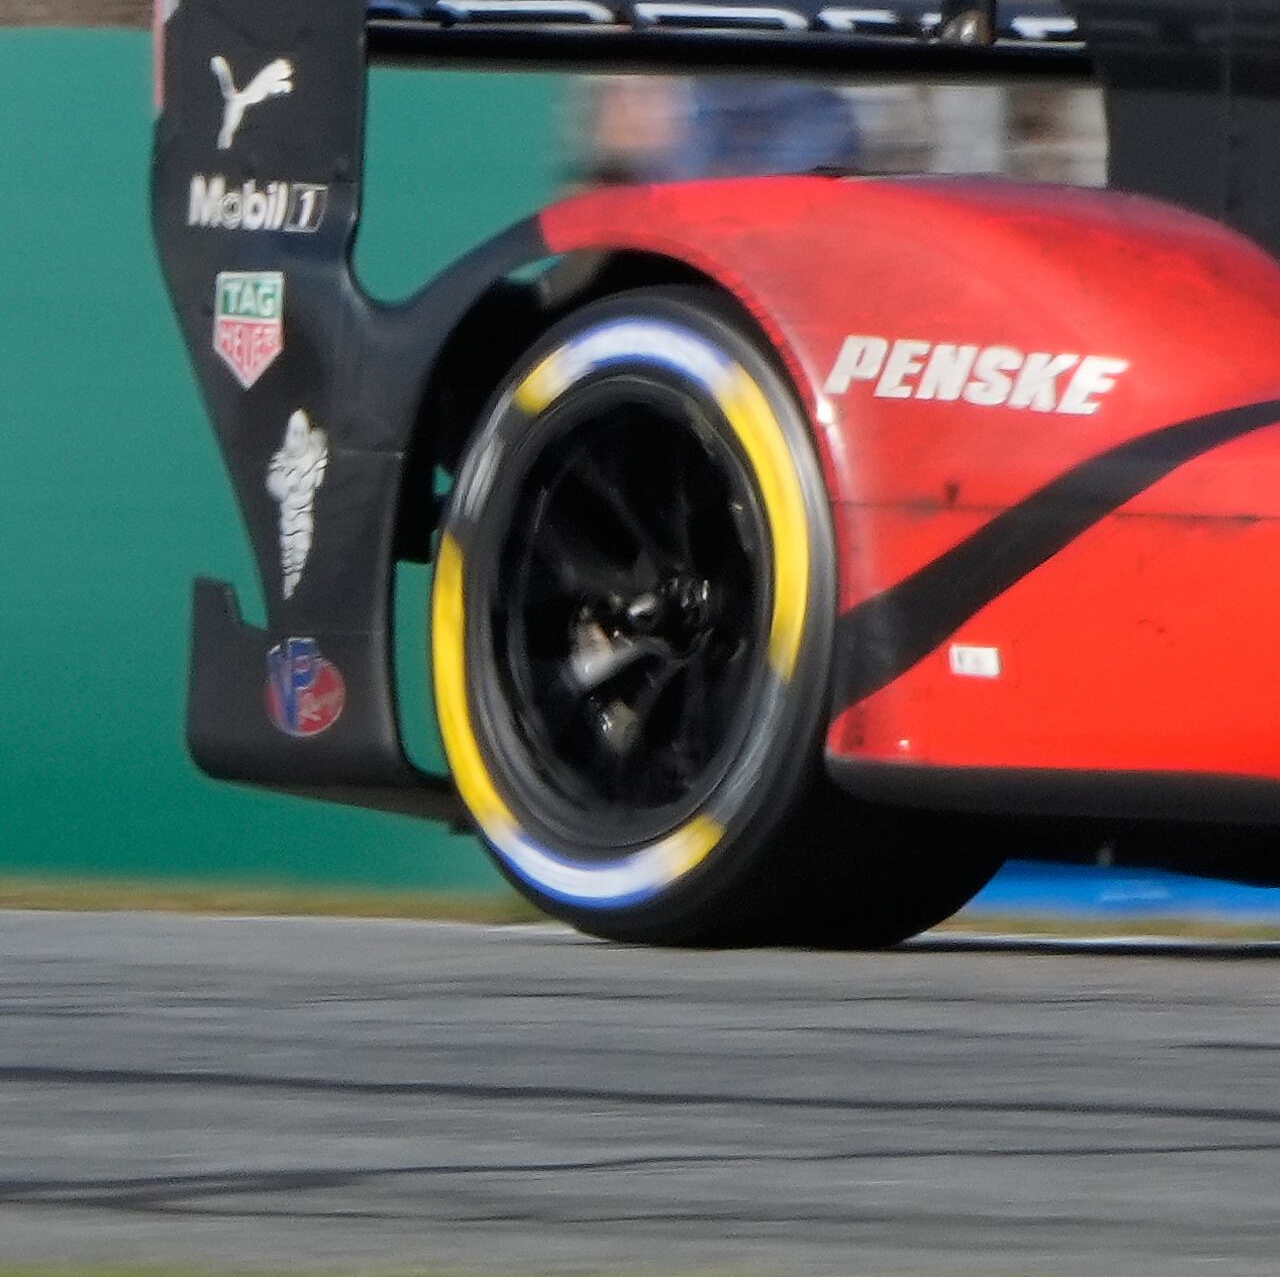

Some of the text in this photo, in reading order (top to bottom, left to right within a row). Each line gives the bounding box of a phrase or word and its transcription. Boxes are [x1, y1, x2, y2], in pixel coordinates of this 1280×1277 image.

[187, 173, 289, 230] Mobil
[221, 279, 279, 319] TAG
[823, 335, 1129, 416] PENSKE
